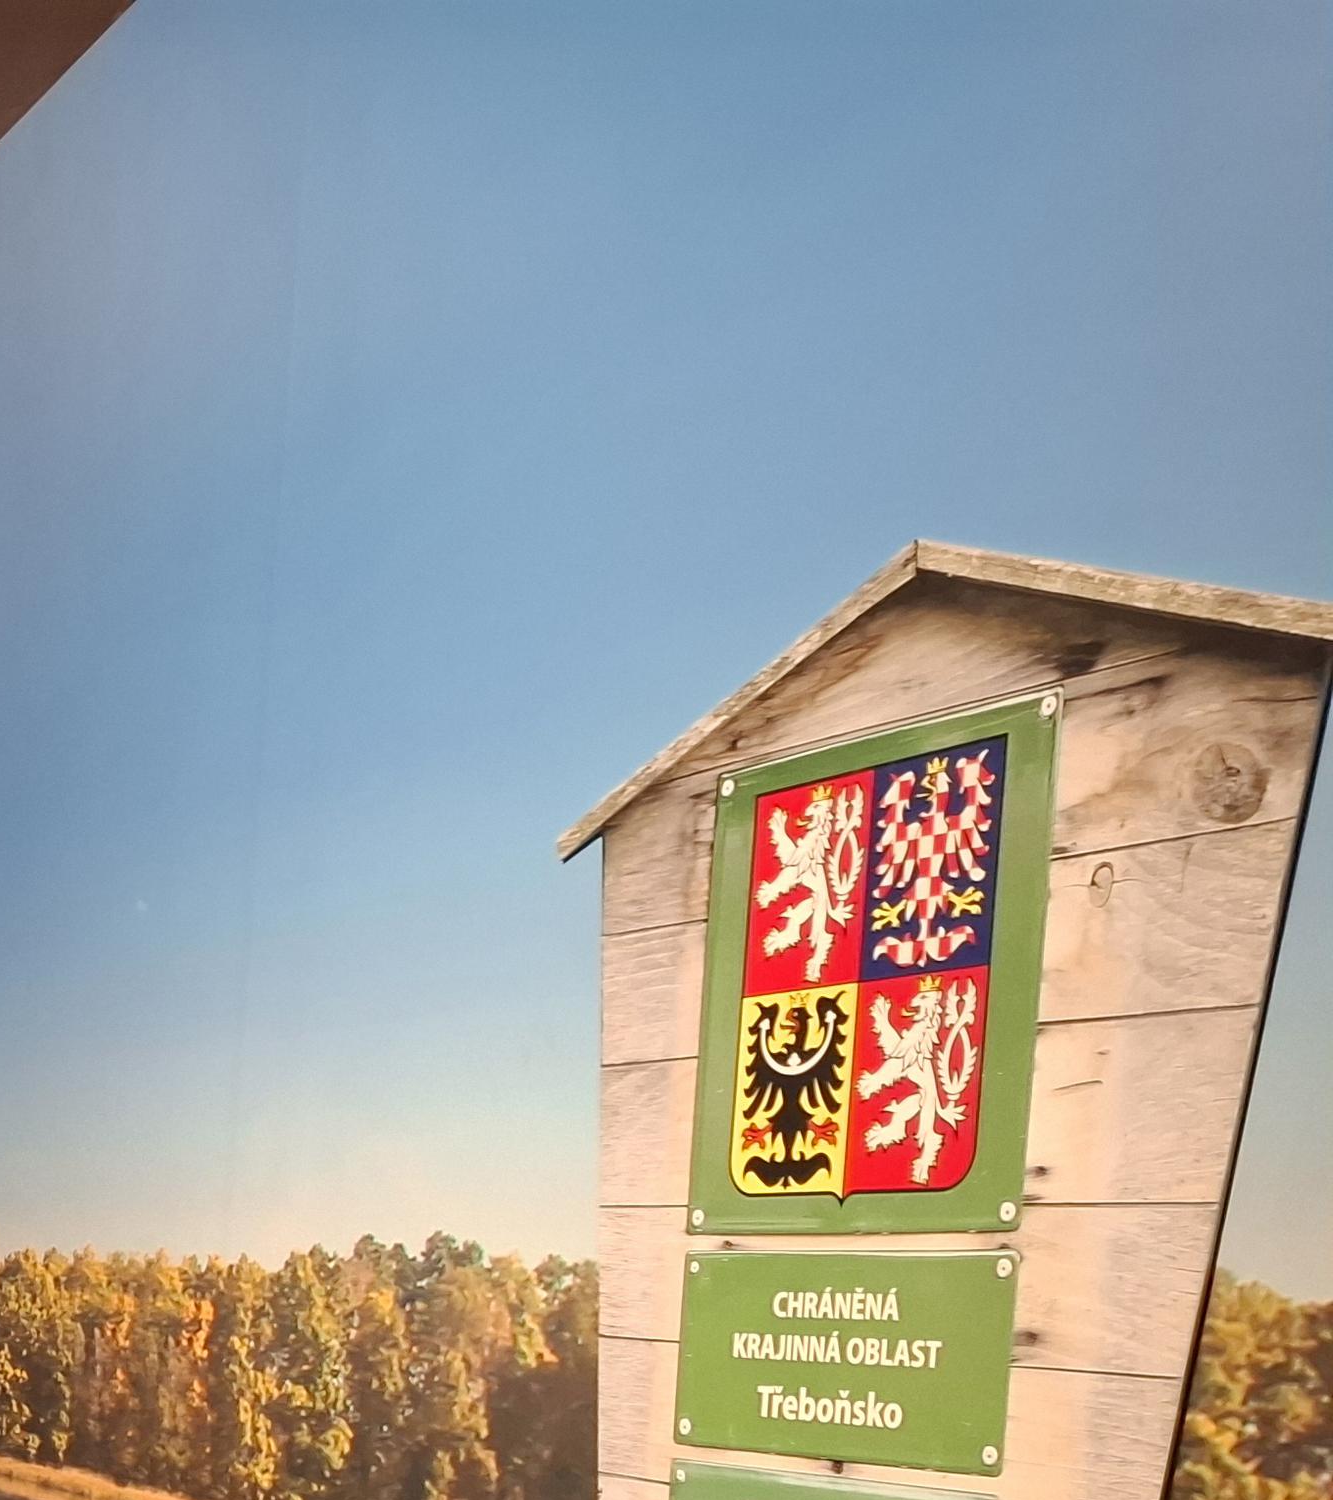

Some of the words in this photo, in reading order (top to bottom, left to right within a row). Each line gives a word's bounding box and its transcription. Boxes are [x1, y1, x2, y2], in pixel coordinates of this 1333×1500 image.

[773, 1286, 899, 1321] CHRÁNĚNÁ
[732, 1330, 841, 1364] KRAJINNÁ
[846, 1337, 943, 1369] OBLAST
[757, 1385, 903, 1429] Třeboňsko
